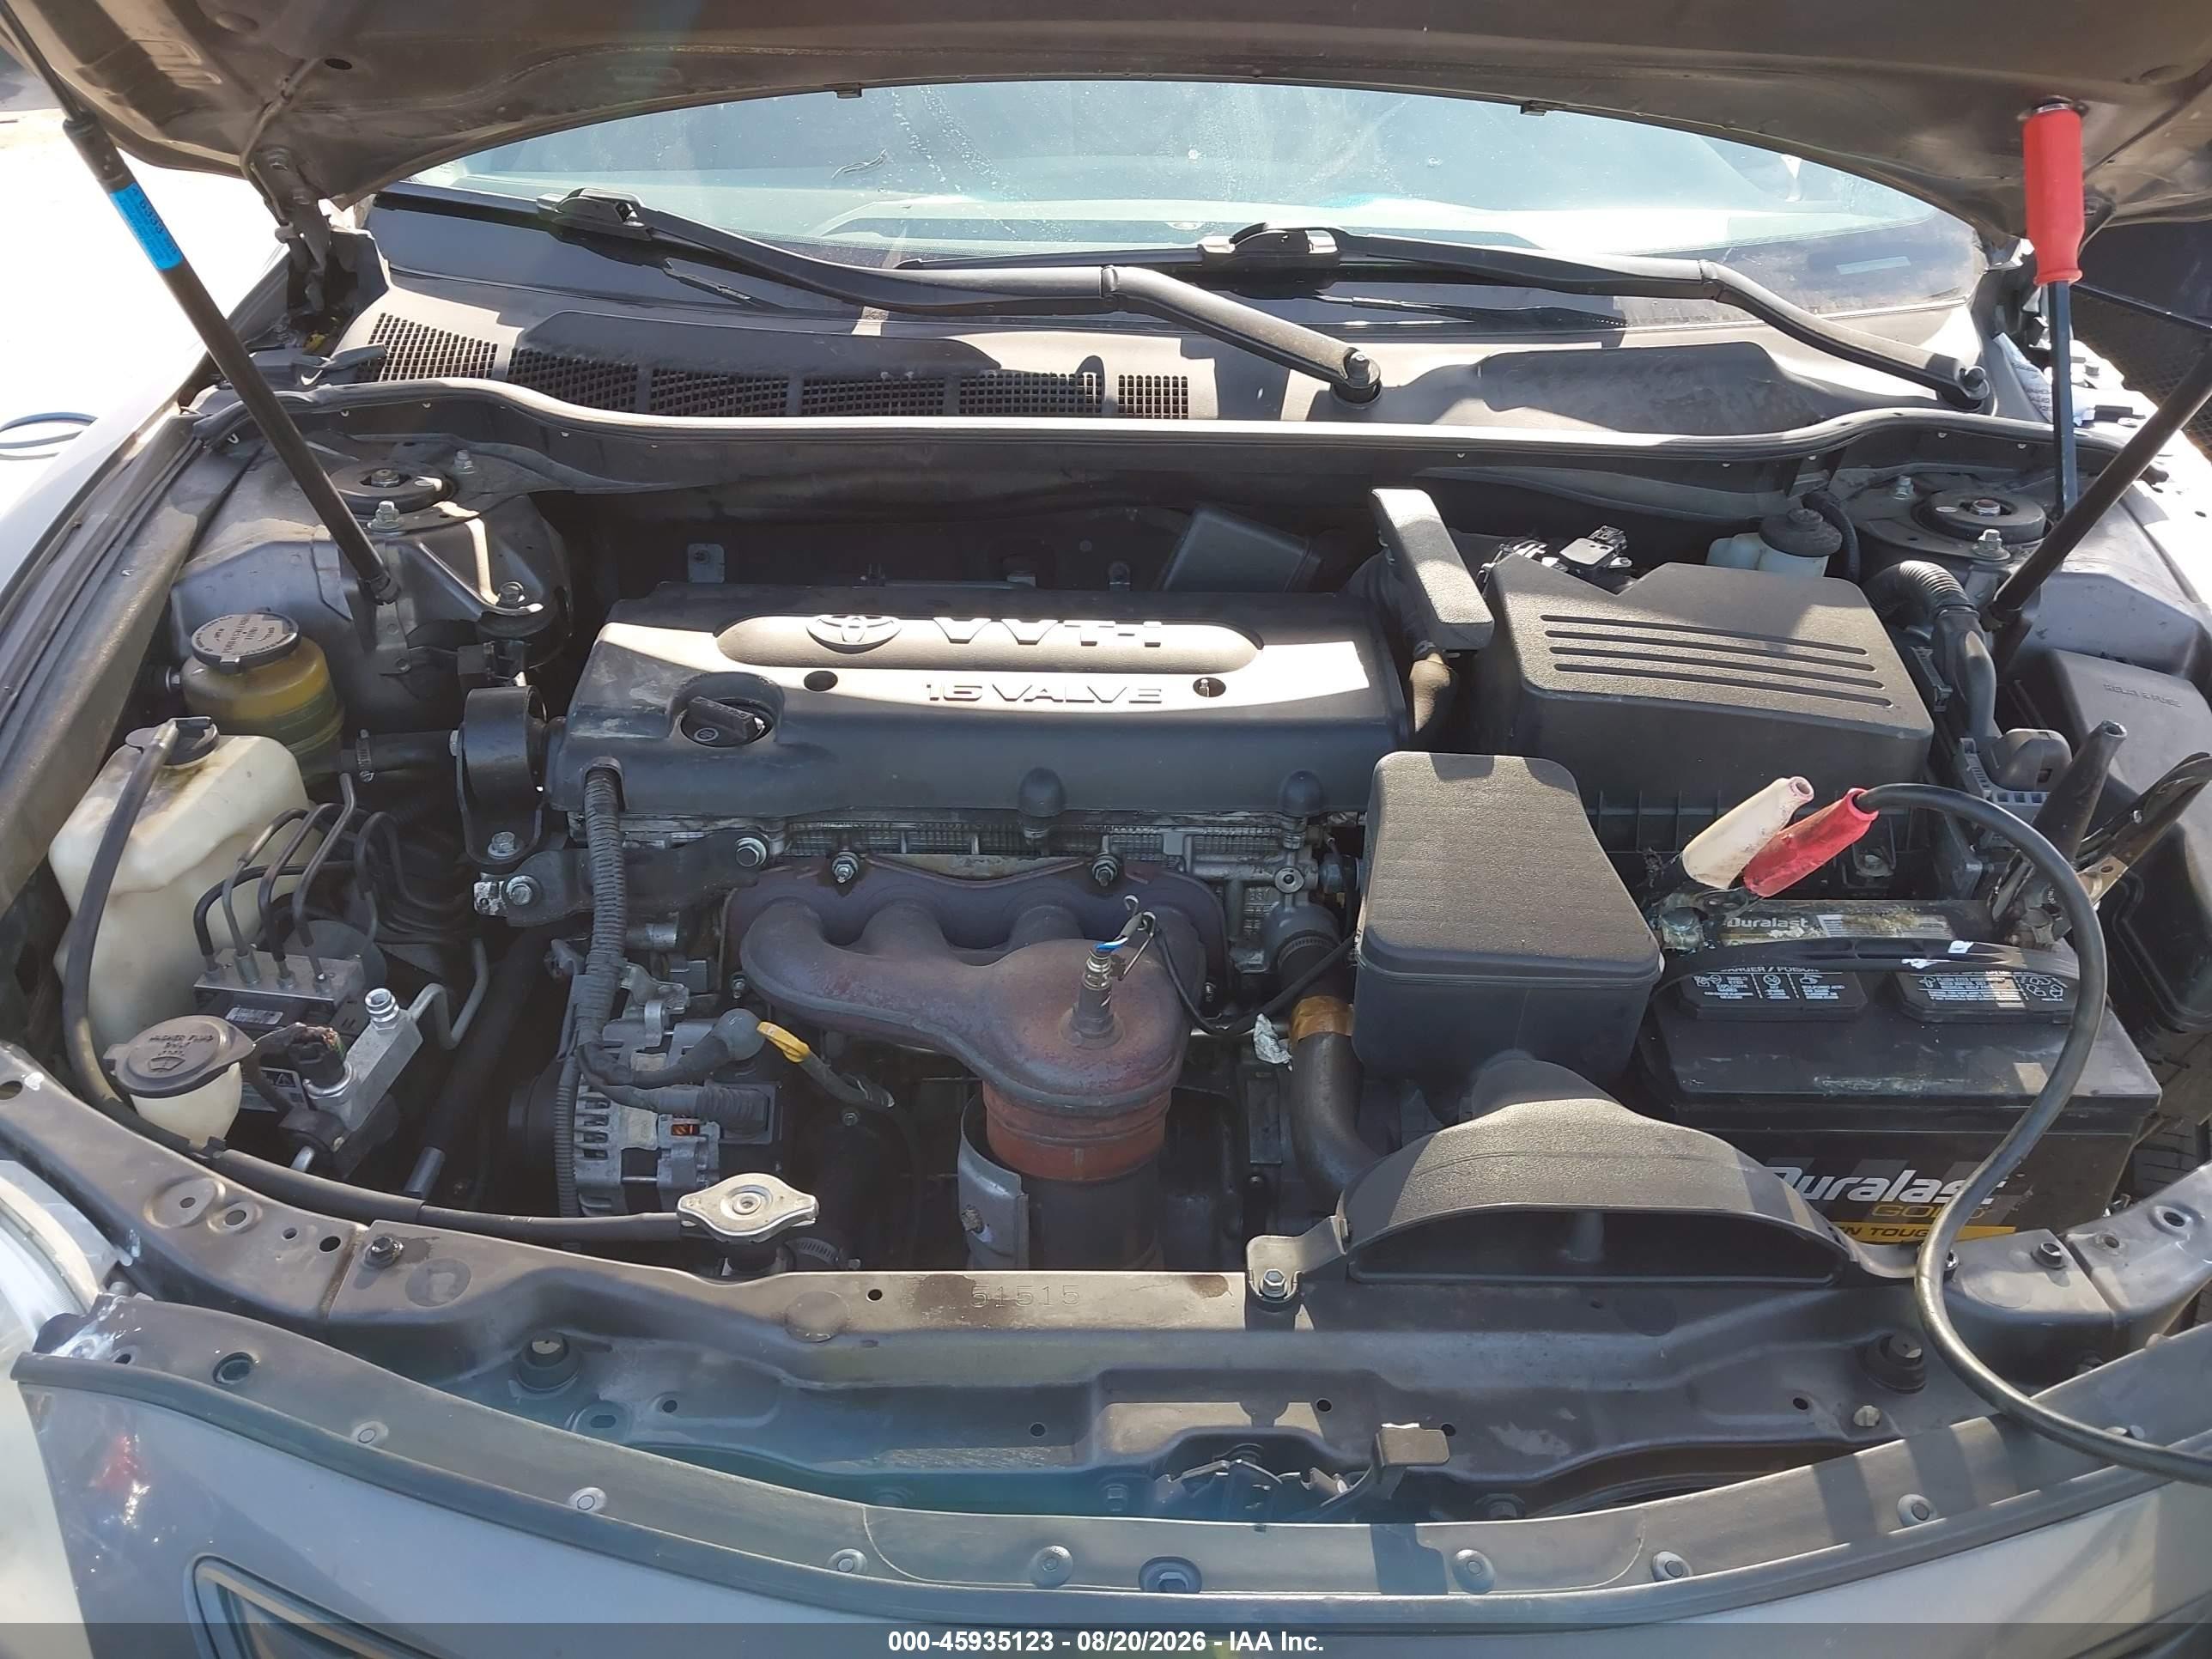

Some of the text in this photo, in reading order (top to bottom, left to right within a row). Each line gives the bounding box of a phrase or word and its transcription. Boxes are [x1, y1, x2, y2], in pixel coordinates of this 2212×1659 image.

[926, 683, 1163, 704] 16 VALVE
[1726, 917, 1809, 928] Duralast
[1764, 1166, 2007, 1204] Duralas
[1869, 1227, 1930, 1237] TOUG
[970, 1285, 1080, 1308] 51515
